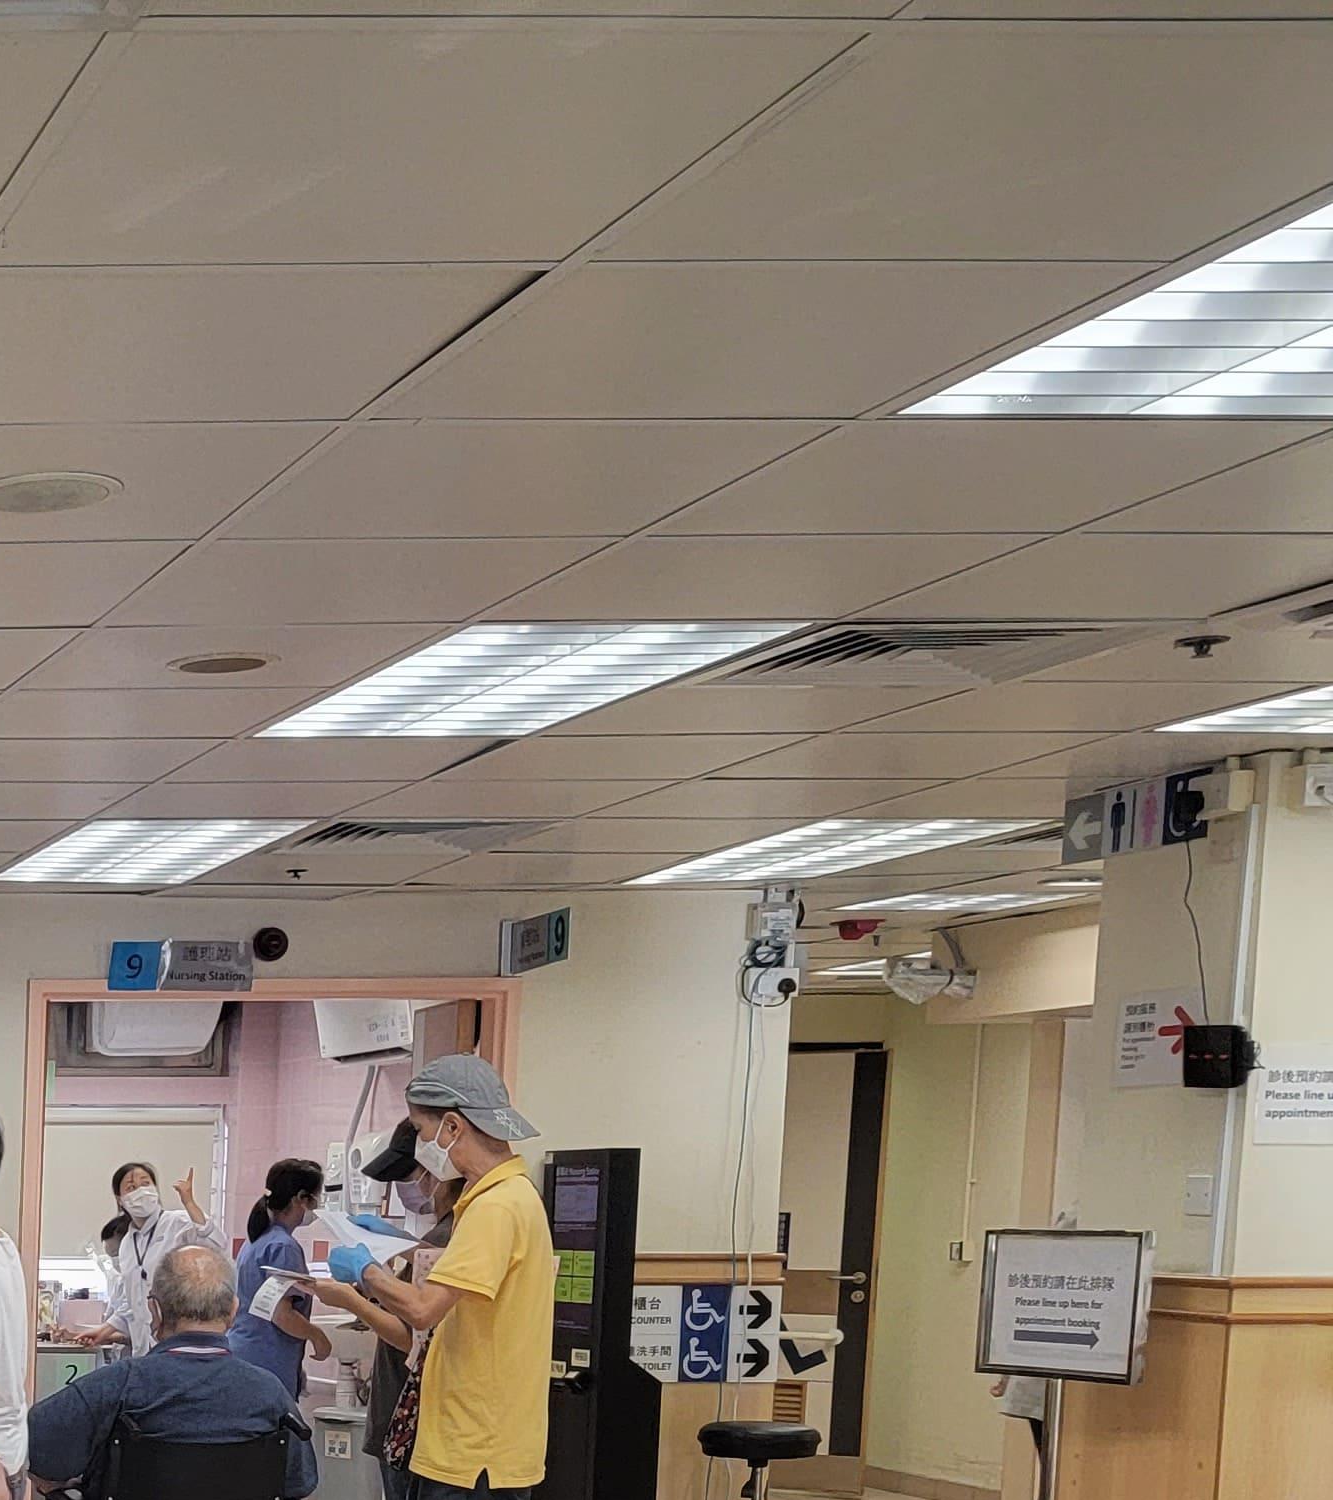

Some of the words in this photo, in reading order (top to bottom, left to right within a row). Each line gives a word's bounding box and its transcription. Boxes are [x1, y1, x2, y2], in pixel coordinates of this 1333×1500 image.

[553, 915, 567, 957] 9
[125, 953, 144, 981] 9
[208, 969, 247, 982] Station
[1264, 1089, 1301, 1100] Please
[1303, 1089, 1325, 1100] line
[1264, 1107, 1333, 1120] appointmen
[634, 1296, 662, 1311] 櫃台
[1015, 1296, 1040, 1307] Please
[1042, 1297, 1057, 1308] line
[1058, 1299, 1069, 1309] up
[1071, 1299, 1089, 1309] here
[1091, 1299, 1103, 1309] for
[631, 1315, 672, 1325] COUNTER
[1015, 1316, 1066, 1328] appointment
[1068, 1318, 1100, 1330] booking
[642, 1362, 673, 1371] TOILET
[64, 1364, 78, 1385] 2
